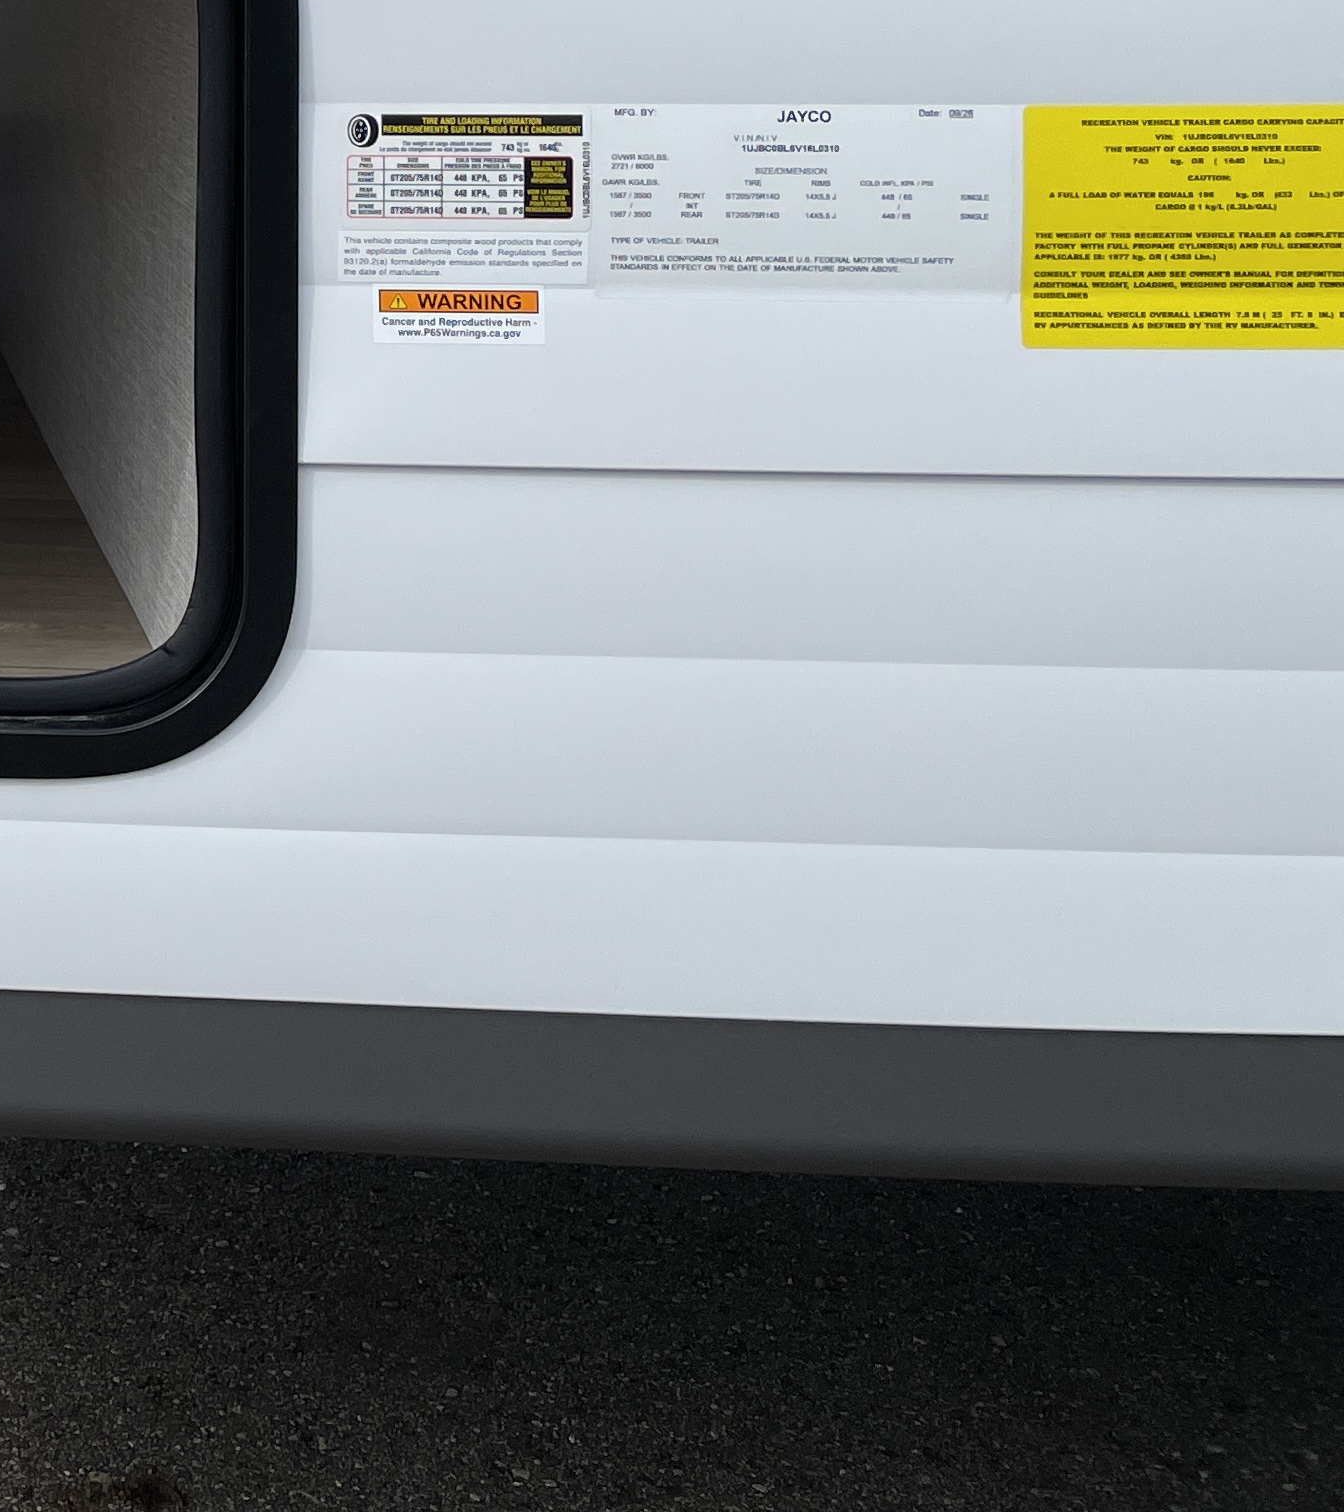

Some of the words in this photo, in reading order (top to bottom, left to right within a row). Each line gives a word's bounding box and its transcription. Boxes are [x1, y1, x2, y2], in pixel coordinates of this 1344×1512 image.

[614, 108, 637, 116] MFG.
[777, 110, 832, 123] JAYCO
[918, 109, 942, 117] Date:
[364, 237, 392, 245] vehicle
[394, 237, 428, 245] contains
[430, 238, 472, 246] composite
[498, 238, 533, 246] products
[535, 238, 549, 246] that
[553, 238, 582, 247] comply
[344, 247, 360, 255] with
[366, 248, 407, 257] applicable
[412, 248, 451, 256] California
[457, 248, 478, 256] Code
[484, 248, 492, 256] of
[498, 249, 546, 257] Regulations
[344, 257, 388, 267] 93120.2(a)
[391, 258, 446, 267] formaldehyde
[489, 259, 529, 267] standards
[532, 259, 568, 268] specified
[344, 268, 356, 276] the
[359, 268, 376, 276] date
[379, 268, 387, 276] of
[389, 269, 442, 277] manufacture.
[417, 293, 522, 310] WARNING
[382, 317, 416, 326] Cancer
[419, 317, 436, 326] and
[439, 318, 503, 328] Reproductive
[506, 319, 531, 327] Harm
[398, 328, 521, 339] www.P65Warnings.ca.gov
